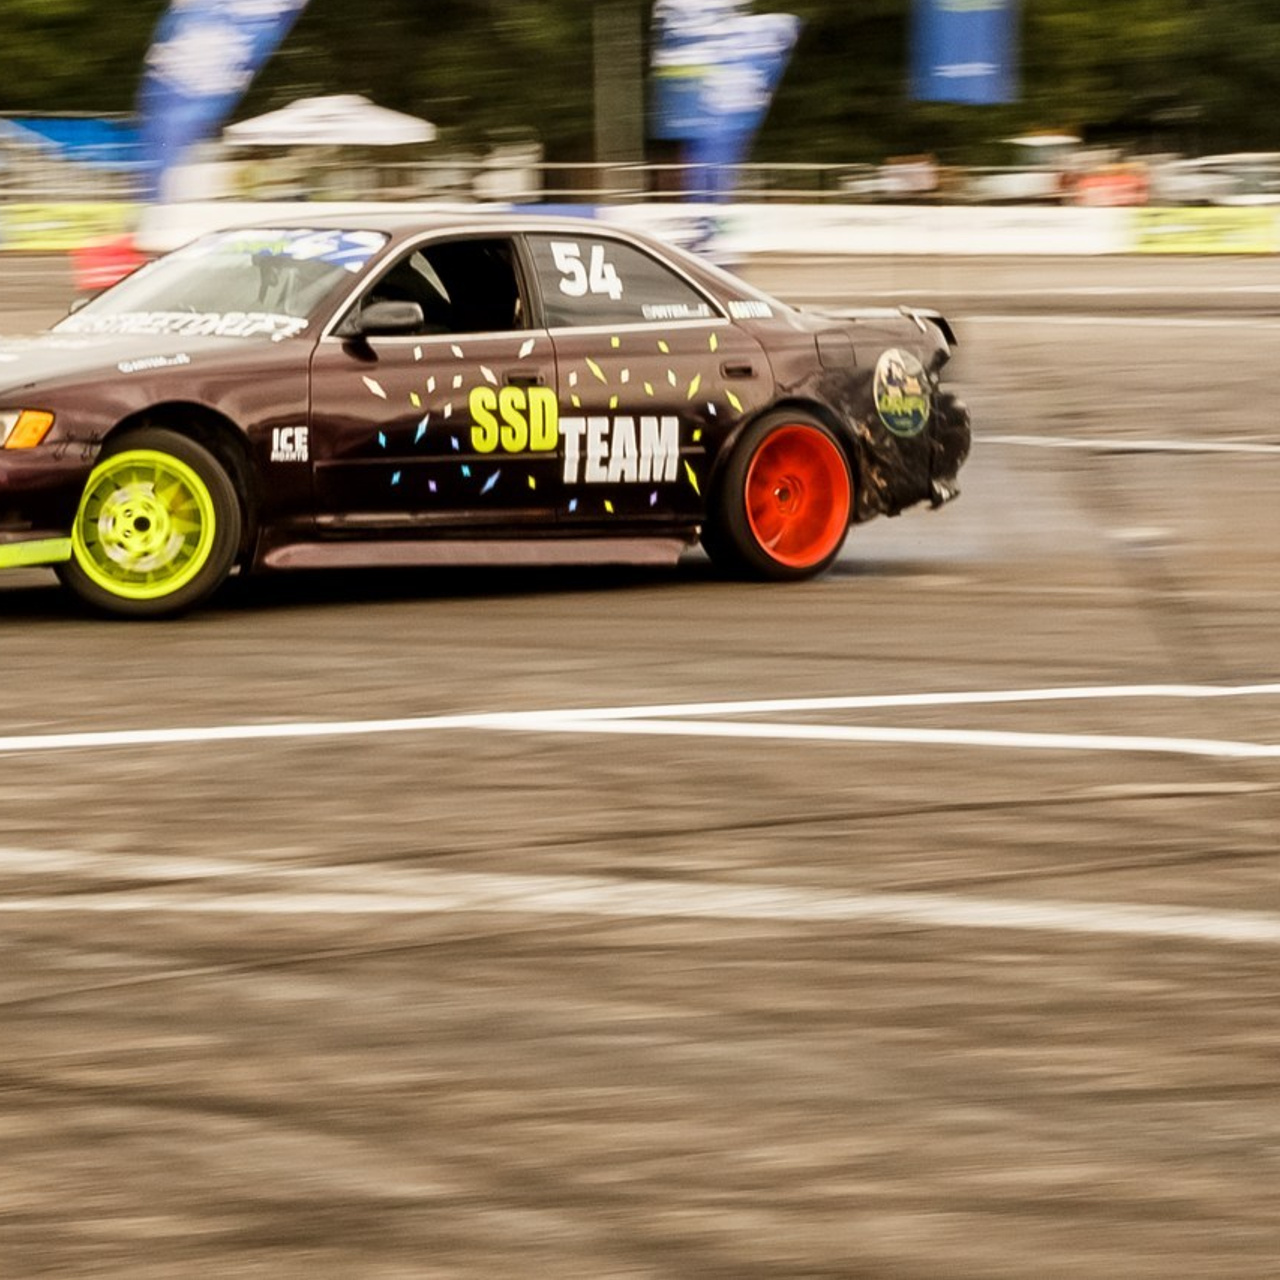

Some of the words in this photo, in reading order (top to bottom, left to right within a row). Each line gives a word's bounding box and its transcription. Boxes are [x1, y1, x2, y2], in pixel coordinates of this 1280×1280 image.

[550, 241, 623, 300] 54
[272, 426, 309, 451] ICE
[469, 386, 558, 453] SSD
[558, 416, 680, 484] TEAM
